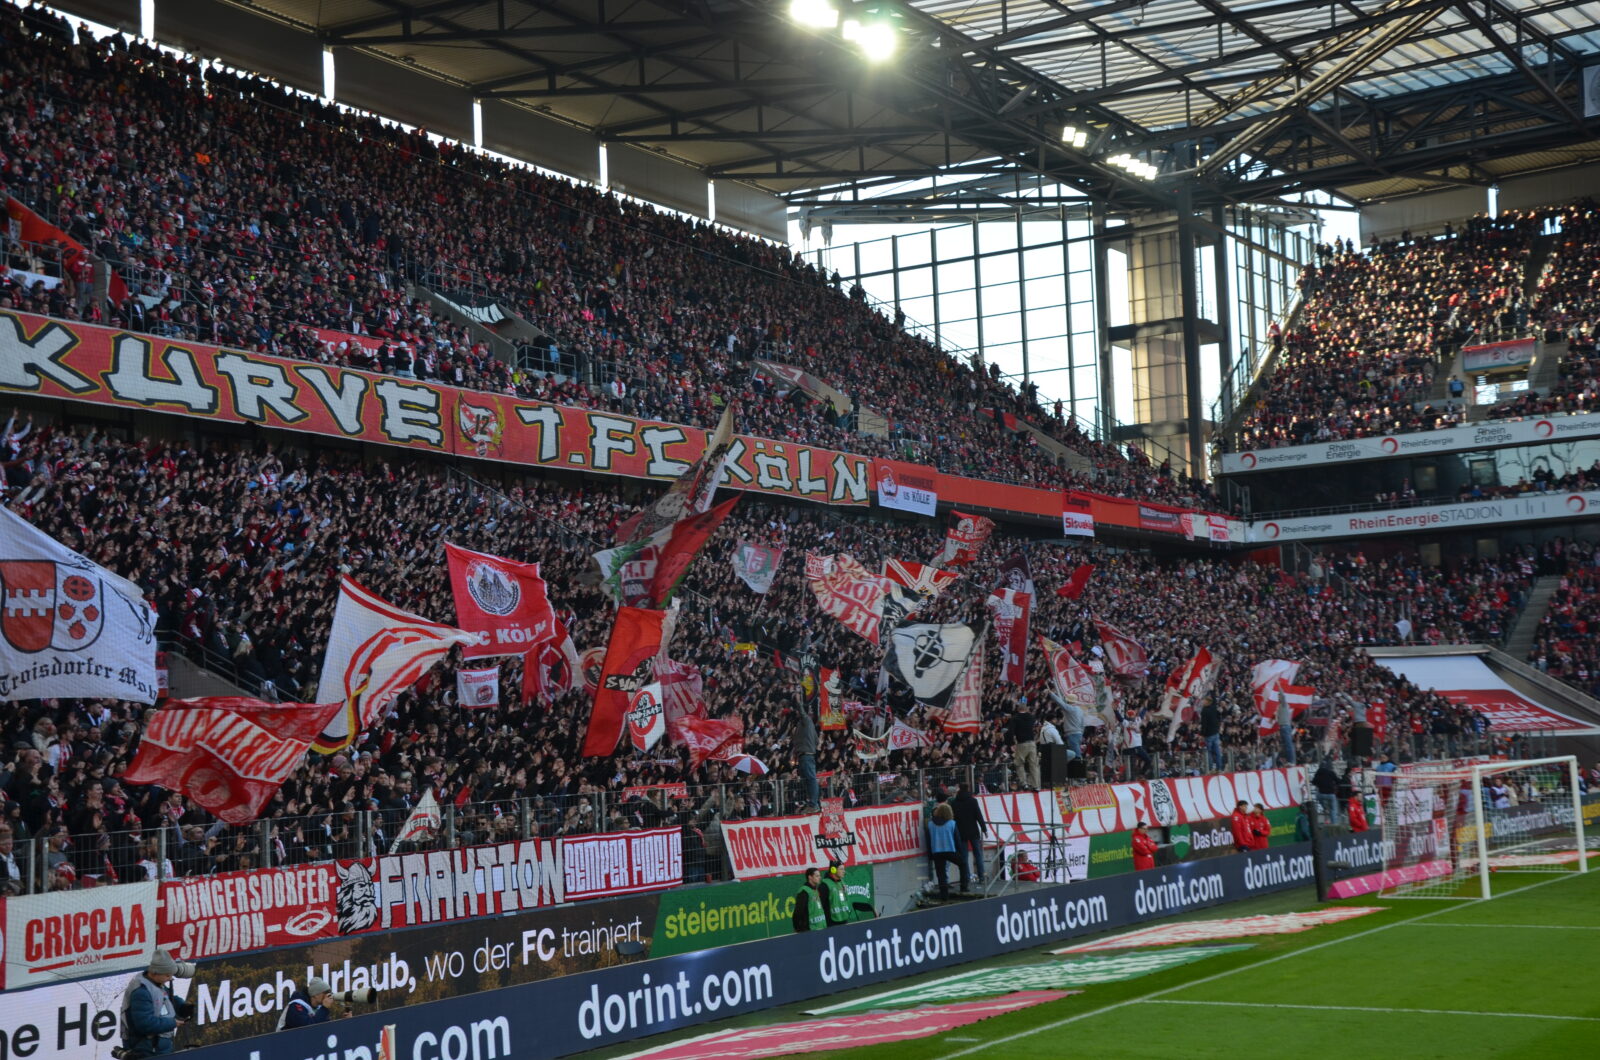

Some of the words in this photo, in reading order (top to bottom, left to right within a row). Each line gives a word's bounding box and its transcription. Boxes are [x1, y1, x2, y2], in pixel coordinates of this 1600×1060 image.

[0, 311, 444, 447] KURVE
[1328, 444, 1355, 452] Rhein
[1401, 437, 1454, 449] RheinEnergie
[1474, 433, 1513, 444] Energie
[1477, 427, 1506, 436] Rhein
[705, 430, 868, 502] KÖLN
[1258, 452, 1308, 464] RheinEnergie
[1326, 450, 1361, 461] Energie
[1281, 523, 1333, 534] RheinEnergie
[1349, 505, 1503, 530] RheinEnergieSTADION
[495, 620, 547, 644] KÖLN
[0, 656, 113, 697] Troisdorfer
[728, 823, 817, 871] DOMSTADT
[855, 809, 920, 856] SYNDIKAT
[1193, 831, 1210, 850] Das
[1211, 826, 1235, 847] Grün
[565, 838, 628, 892] SEMPER
[631, 832, 682, 886] FIDELIS
[1091, 845, 1133, 864] steiermark.c
[1244, 851, 1314, 890] dorint.com
[1135, 872, 1224, 915] dorint.com
[25, 904, 146, 962] CRICCAA
[180, 912, 266, 960] STADION
[665, 892, 796, 939] steiermark.c
[996, 894, 1108, 944] dorint.com
[76, 954, 102, 966] KÖLN
[198, 971, 296, 1026] Mach
[425, 951, 464, 982] wo
[473, 937, 514, 974] der
[522, 927, 556, 966] FC
[562, 915, 647, 958] trainiert.
[819, 924, 963, 984] dorint.com
[578, 964, 773, 1040] dorint.com
